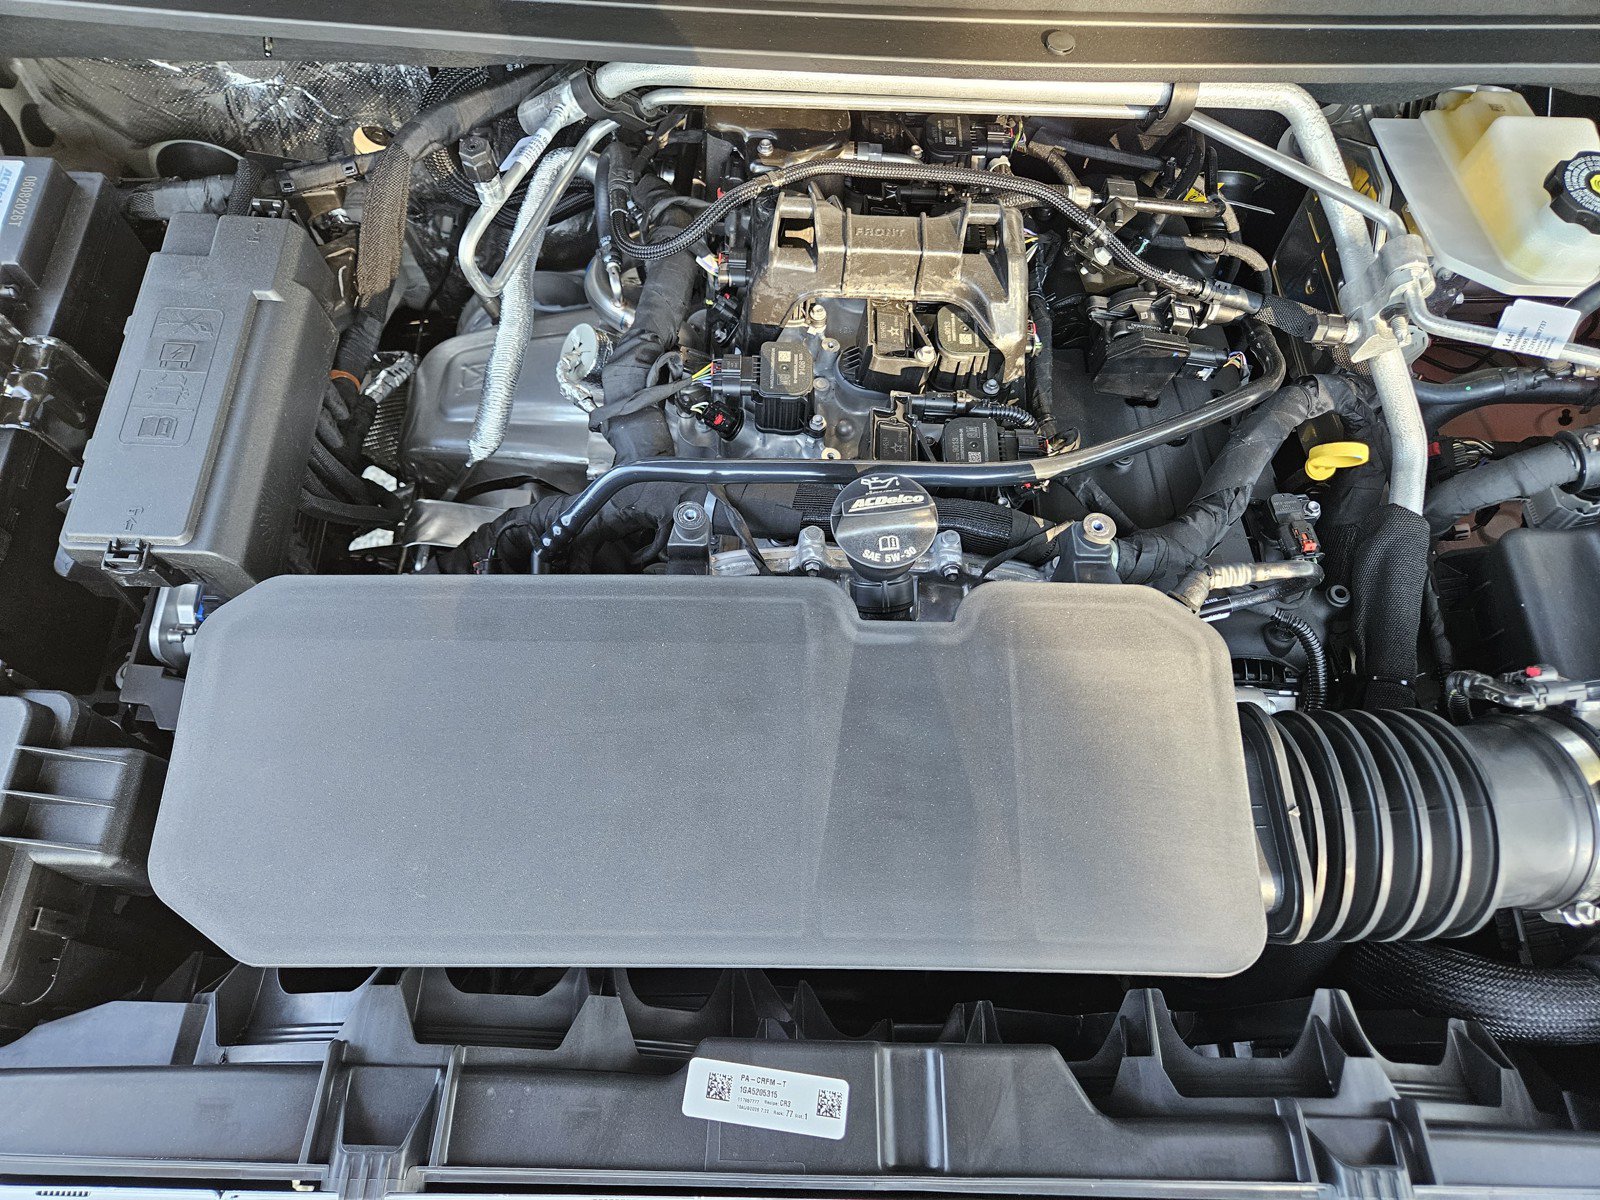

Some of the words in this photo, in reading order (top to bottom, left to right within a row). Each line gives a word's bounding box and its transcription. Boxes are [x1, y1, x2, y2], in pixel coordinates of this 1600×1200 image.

[8, 175, 38, 228] 06082026T
[854, 226, 905, 237] FRONT
[850, 494, 925, 509] ACDelco
[862, 549, 881, 562] SAE
[884, 546, 917, 563] 5W-30
[739, 1086, 778, 1099] 1GA5205315
